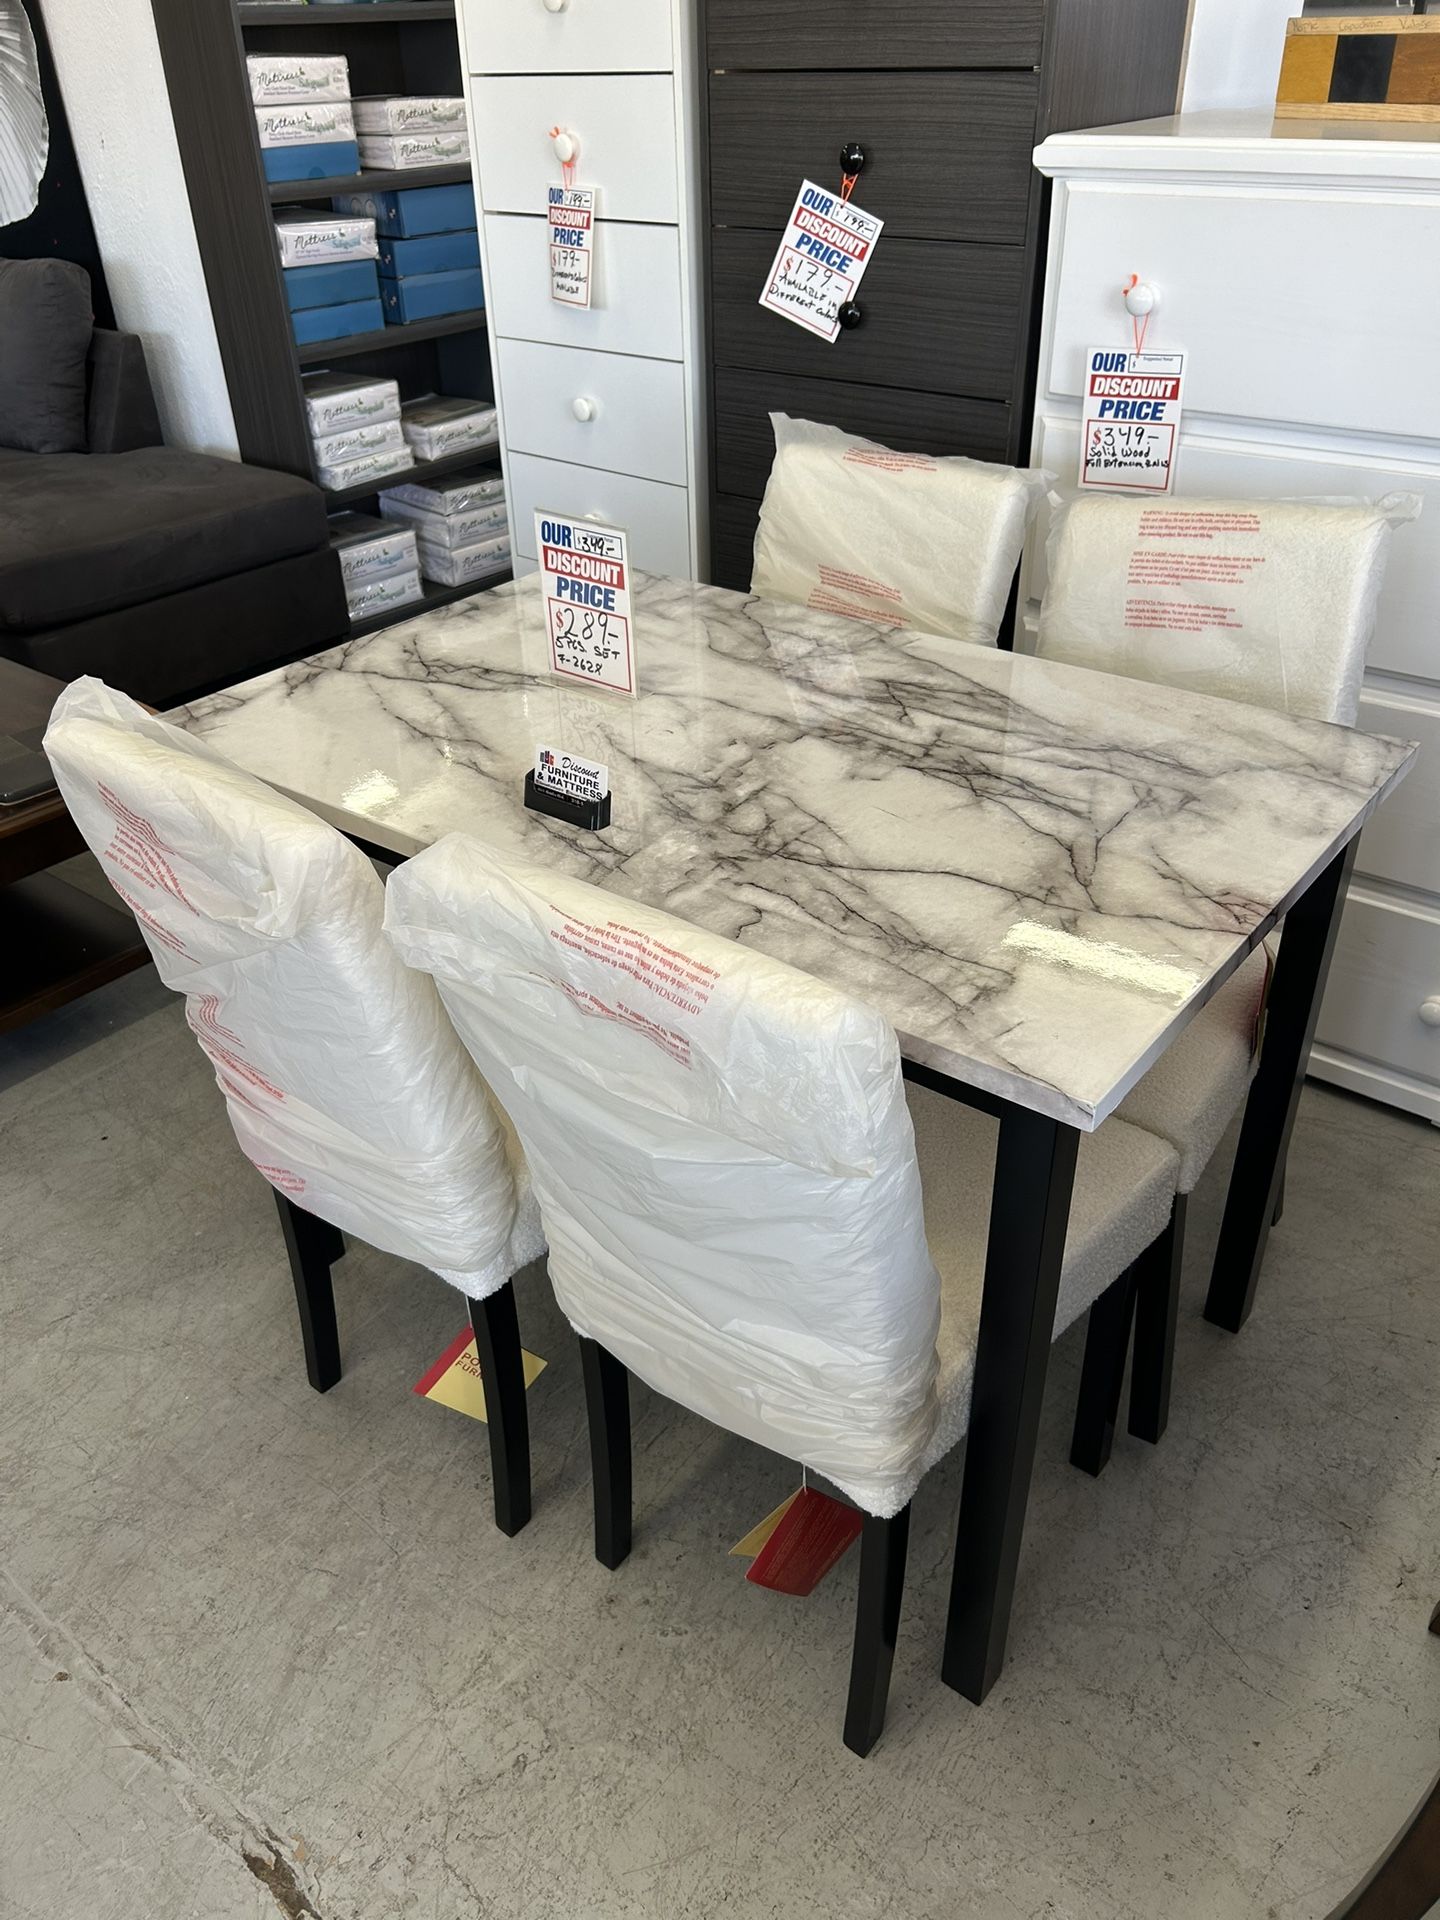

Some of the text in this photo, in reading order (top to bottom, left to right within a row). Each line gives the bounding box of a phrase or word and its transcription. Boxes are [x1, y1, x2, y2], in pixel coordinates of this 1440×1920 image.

[549, 187, 564, 204] OUR
[802, 188, 834, 216] OUR
[550, 208, 590, 228] DISCOUNT
[294, 232, 337, 249] Mattress
[554, 228, 585, 247] PRICE
[797, 211, 868, 259] DISCOUNT
[795, 233, 853, 274] PRICE
[1092, 352, 1127, 373] OUR
[1093, 377, 1176, 398] DISCOUNT
[1098, 399, 1166, 421] PRICE
[541, 520, 571, 549] OUR
[547, 551, 621, 585] DISCOUNT
[556, 576, 616, 612] PRICE
[541, 763, 599, 790] FURNITURE
[562, 757, 599, 779] Discount
[537, 772, 544, 781] &
[548, 775, 603, 800] MATTRESS
[658, 956, 674, 970] bolsa
[641, 977, 655, 990] Para
[653, 985, 703, 1016] ADVERTENCIA:
